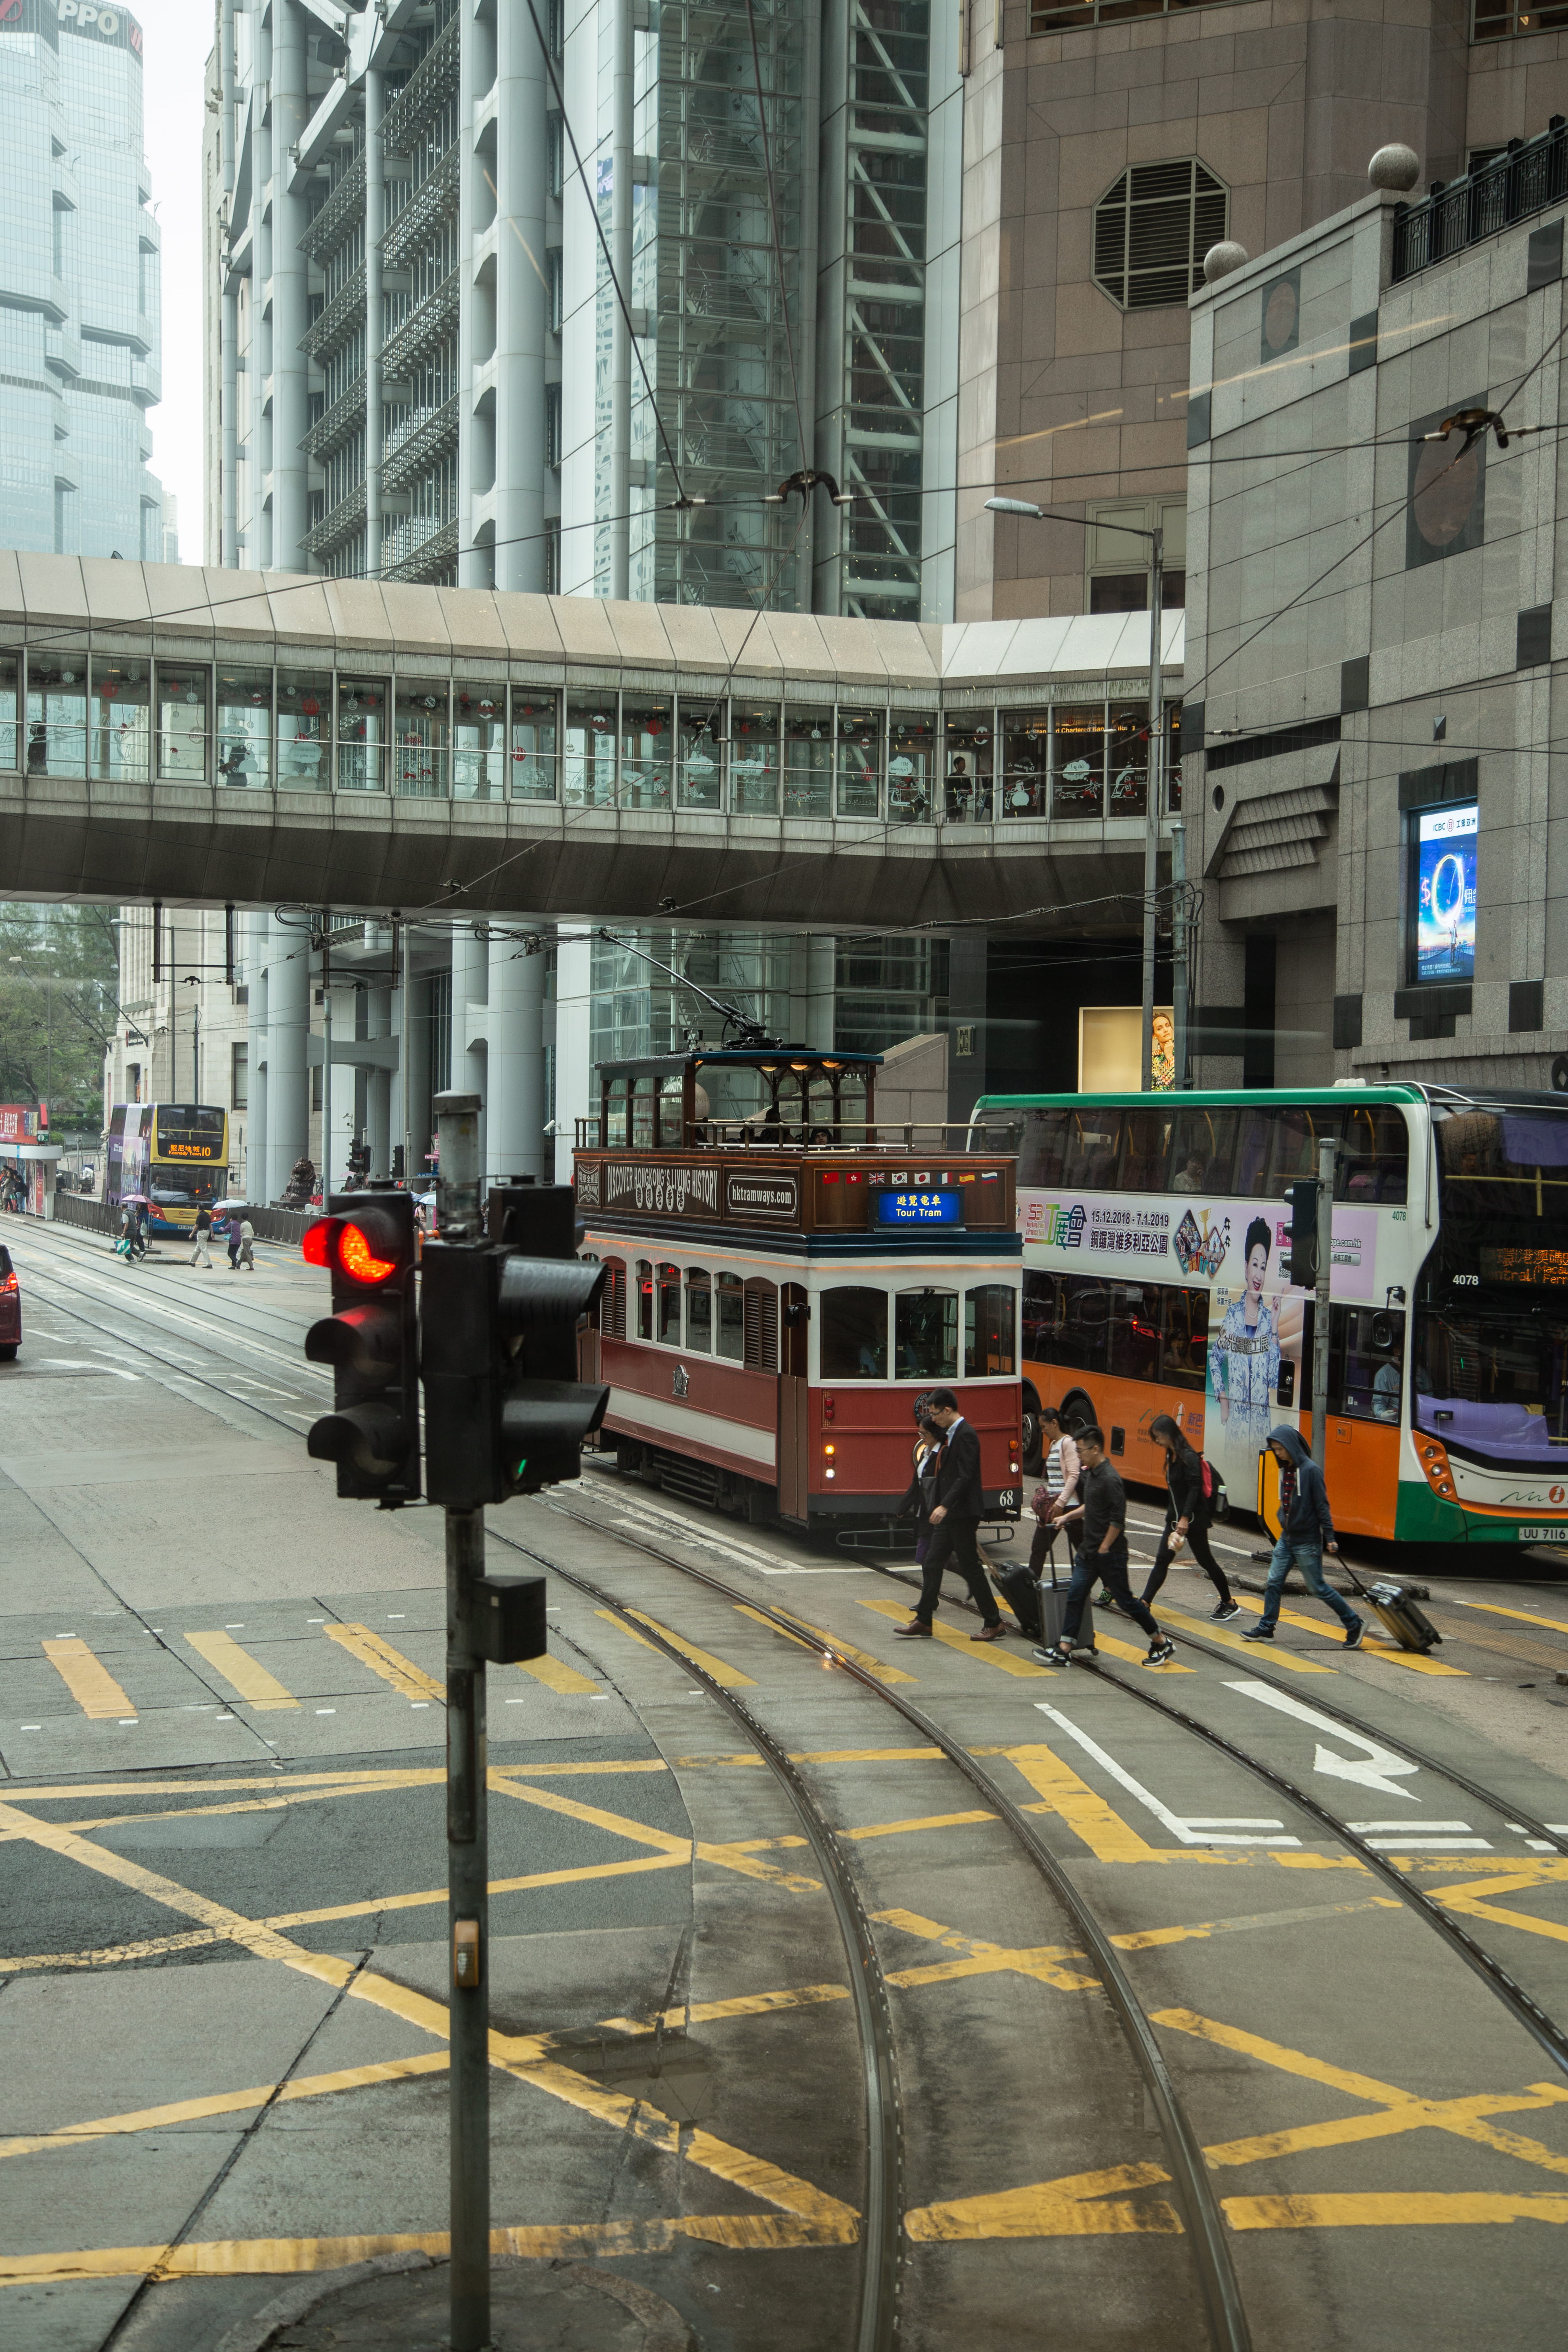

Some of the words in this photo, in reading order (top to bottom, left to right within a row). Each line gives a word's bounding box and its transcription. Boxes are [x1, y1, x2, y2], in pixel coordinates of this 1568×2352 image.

[1433, 822, 1446, 832] ICBC
[170, 1144, 200, 1152] 堅尼地城
[201, 1147, 211, 1157] 10
[607, 1165, 633, 1203] DISCOVER
[671, 1169, 691, 1194] LIVING
[692, 1169, 718, 1211] HISTORY
[732, 1186, 792, 1206] hktramways.com
[896, 1195, 941, 1207] 遊覽電車
[896, 1209, 916, 1217] Tour
[918, 1209, 942, 1217] Tram
[1392, 1211, 1406, 1221] 4078
[1092, 1210, 1131, 1225] 15.12.2018
[1136, 1212, 1169, 1228] 7.1.2019
[1090, 1230, 1169, 1255] 銅鑼灣維多利亞公園
[1452, 1274, 1479, 1285] 4078
[1187, 1412, 1203, 1427] 新巴
[999, 1490, 1014, 1506] 68
[1524, 1529, 1538, 1539] UU
[1543, 1529, 1566, 1539] 7116
